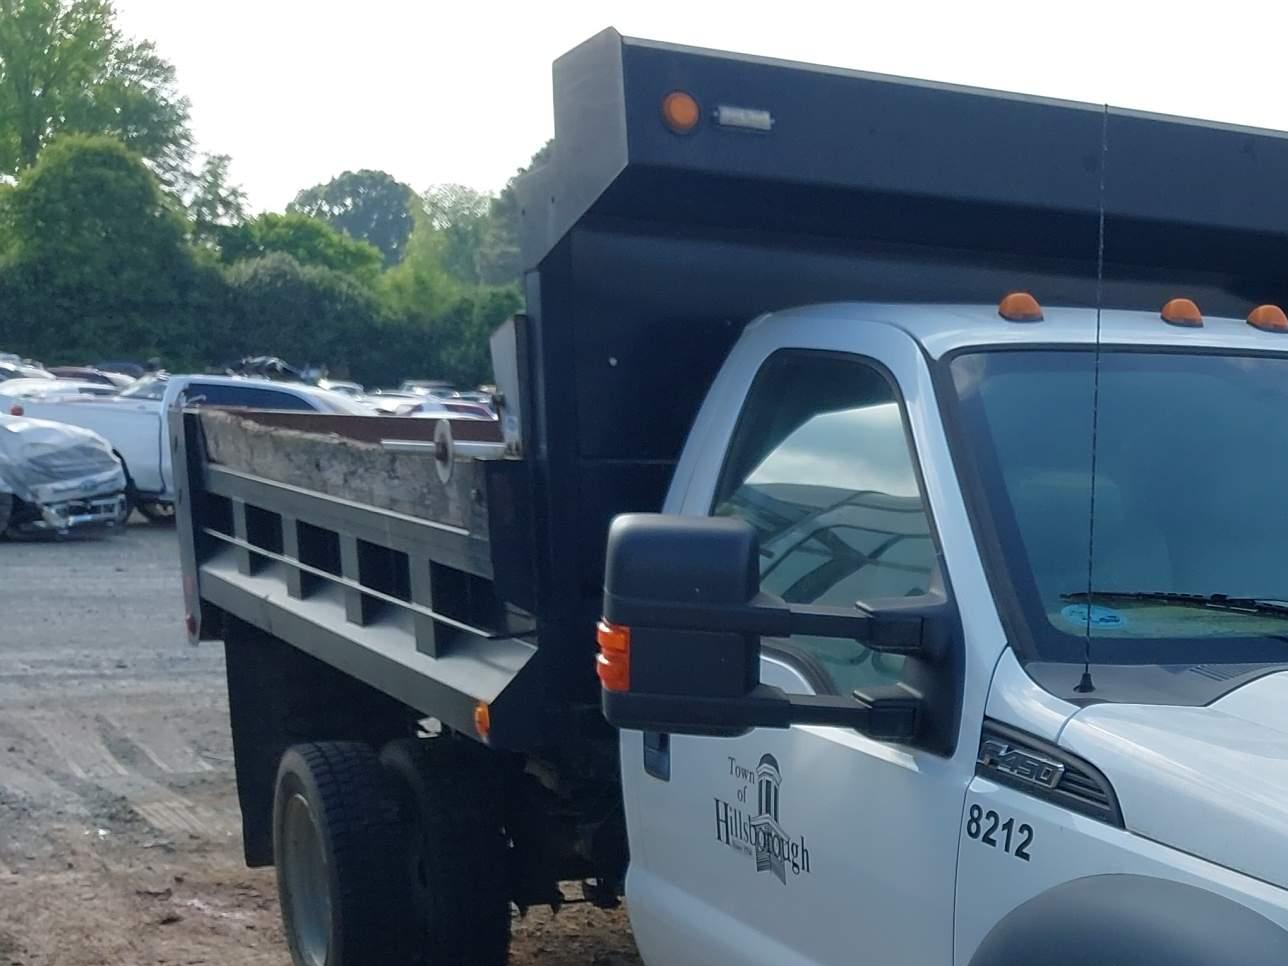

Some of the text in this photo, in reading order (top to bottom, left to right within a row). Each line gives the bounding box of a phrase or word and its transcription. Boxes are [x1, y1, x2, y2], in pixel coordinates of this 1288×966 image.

[728, 756, 756, 784] Town
[737, 785, 748, 803] of
[714, 797, 811, 875] Hillsborough
[966, 803, 1034, 861] 8212
